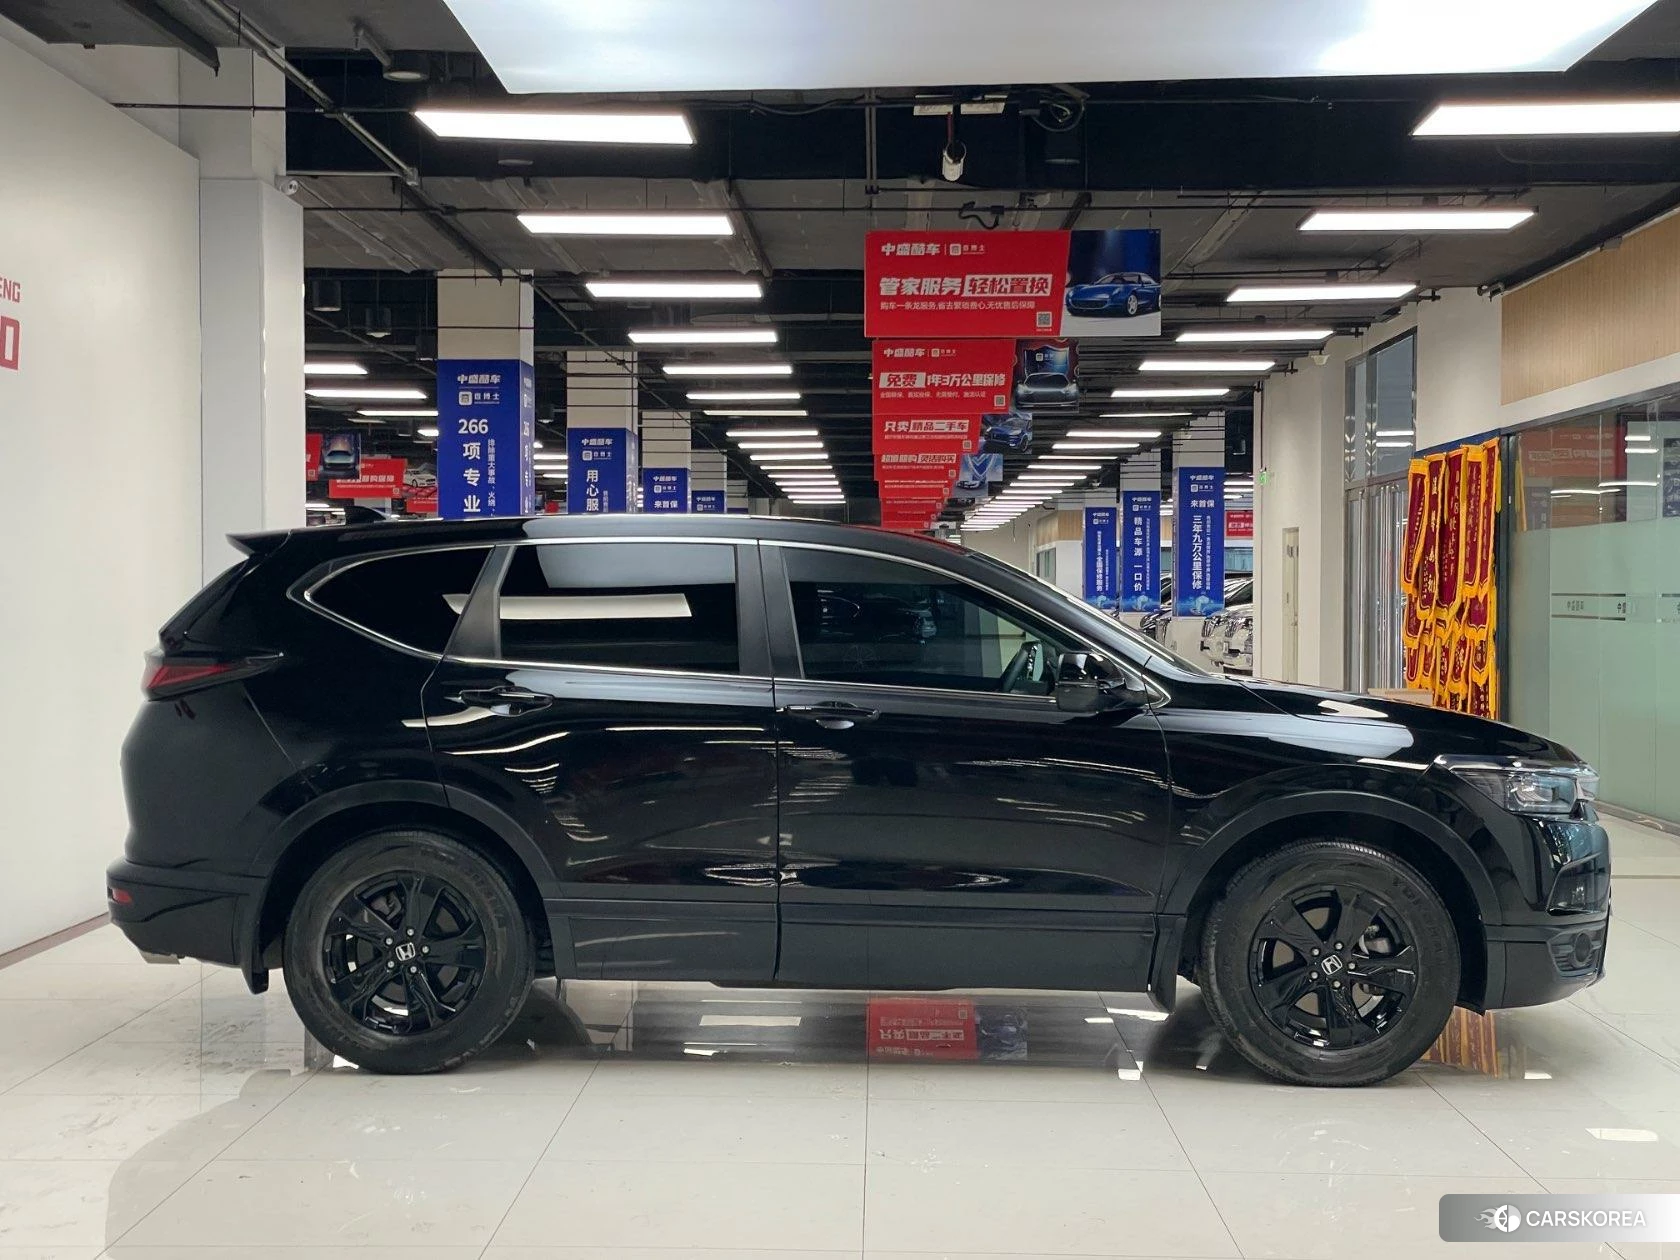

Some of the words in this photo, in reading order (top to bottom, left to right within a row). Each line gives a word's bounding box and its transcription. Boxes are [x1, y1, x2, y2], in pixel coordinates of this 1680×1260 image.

[881, 243, 940, 256] 中盛酷车
[457, 374, 501, 384] 中盛酷车
[887, 374, 917, 387] 免费
[458, 418, 489, 434] 266
[884, 421, 968, 432] 只卖精品二手车
[463, 442, 481, 513] 项专业
[586, 469, 599, 511] 用心服
[654, 500, 678, 509] 来首保
[1190, 500, 1214, 508] 来首保
[1192, 515, 1203, 590] 三年九万公里保修
